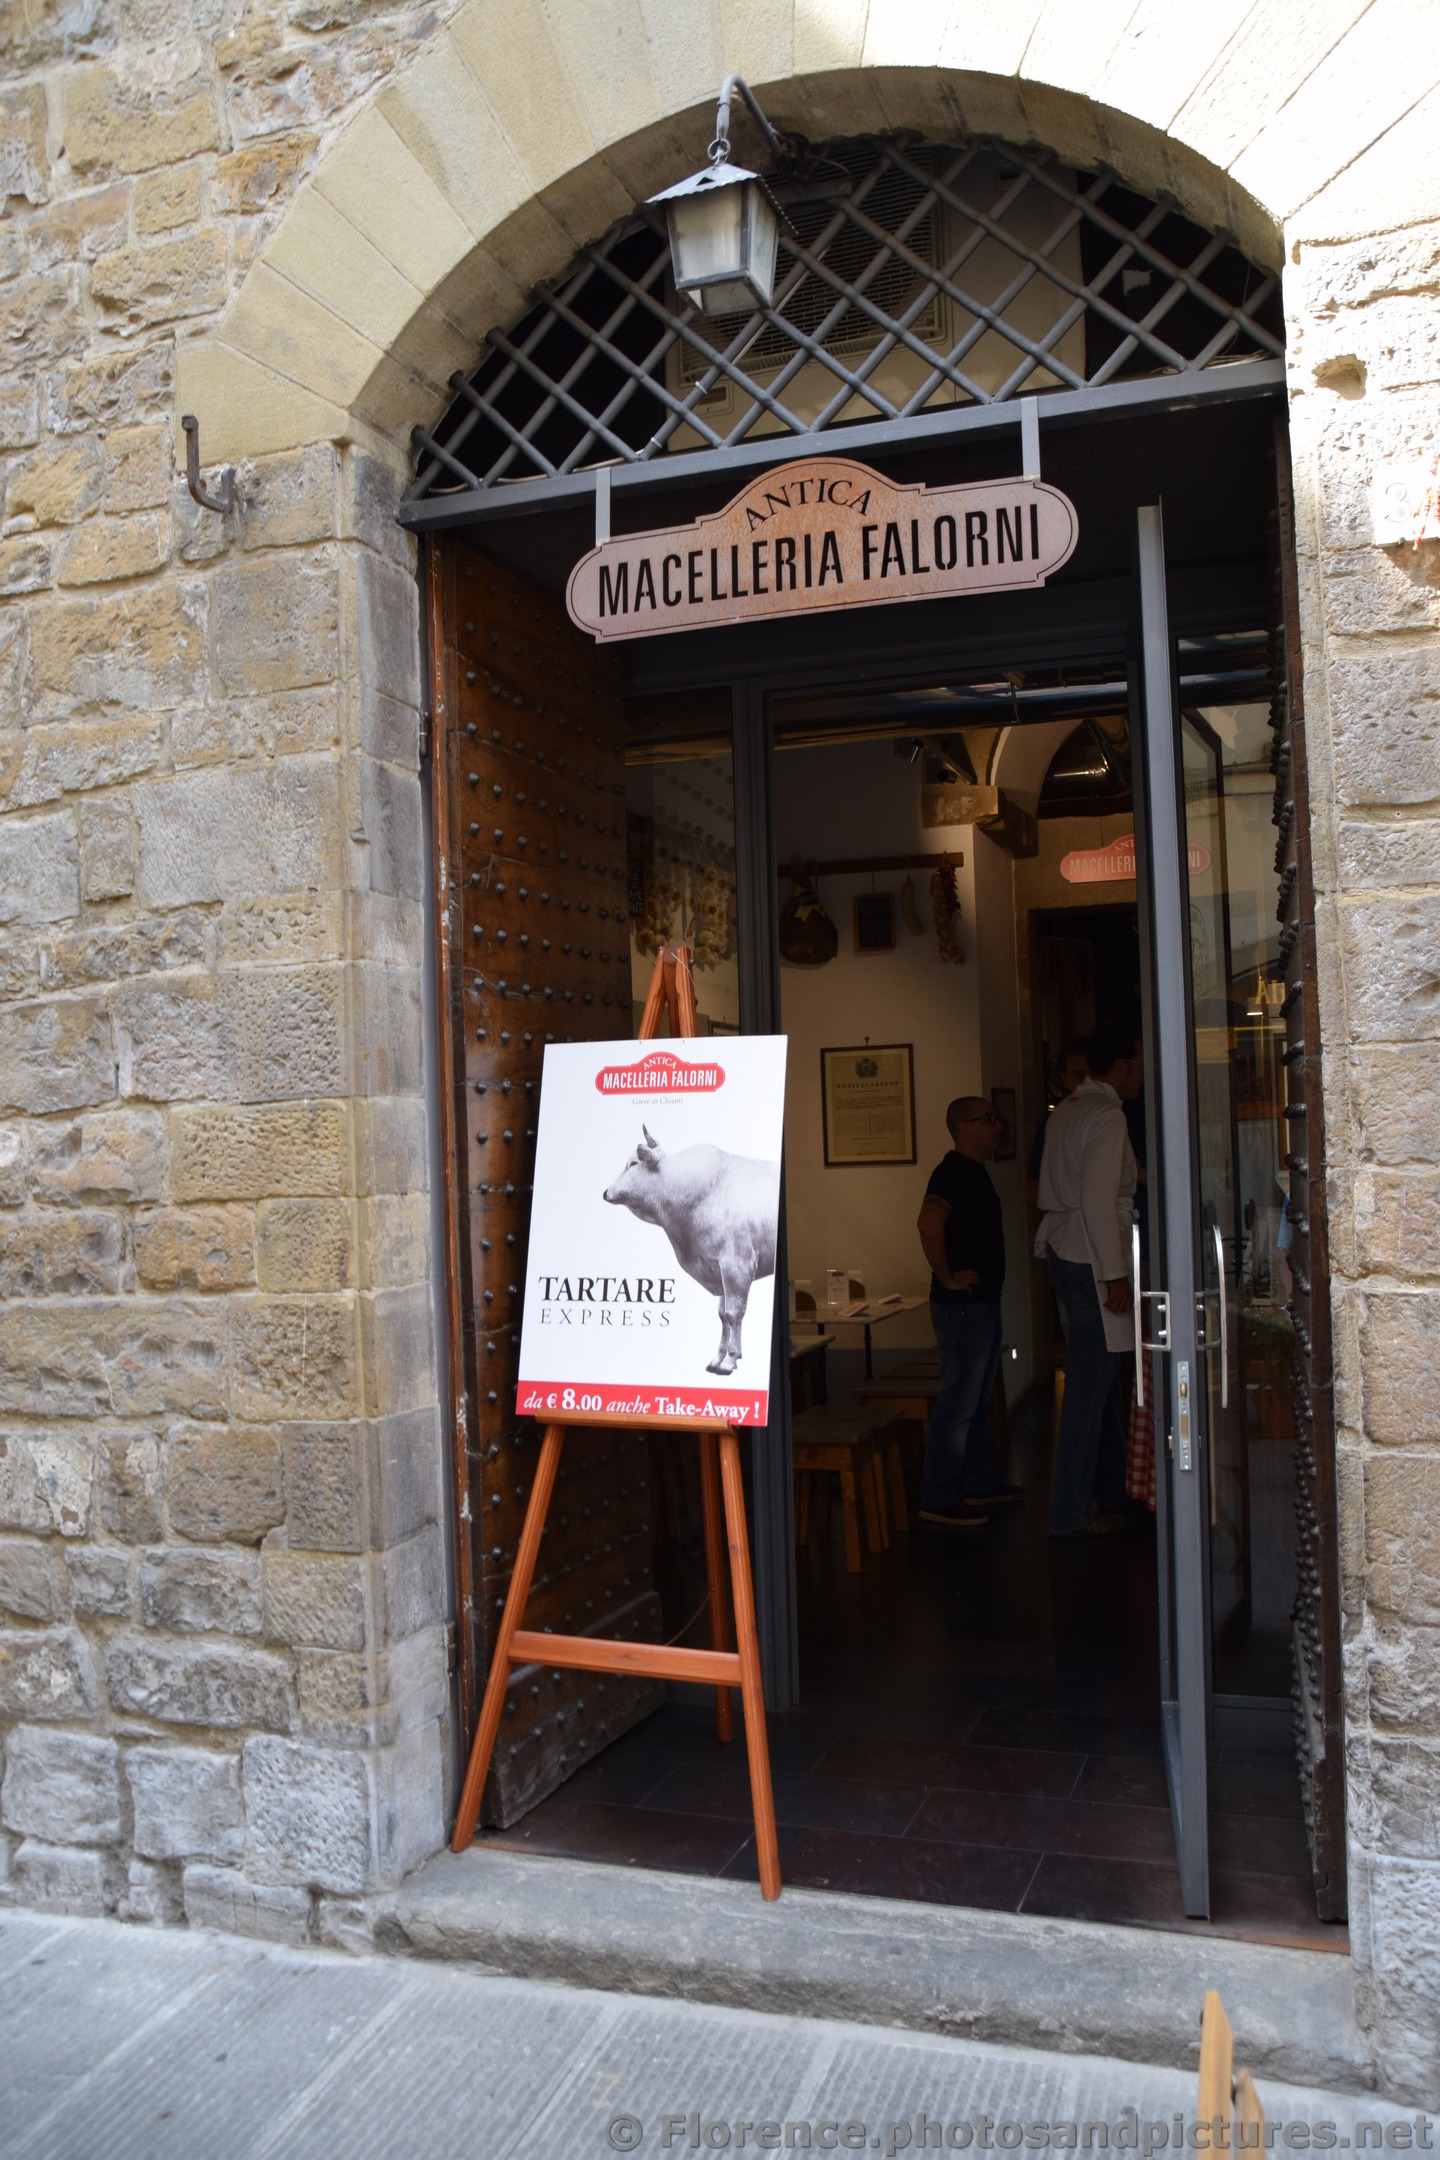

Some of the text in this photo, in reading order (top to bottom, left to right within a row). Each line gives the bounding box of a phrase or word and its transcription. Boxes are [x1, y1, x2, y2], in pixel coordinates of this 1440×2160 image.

[744, 478, 873, 532] ANTICA
[599, 504, 1039, 617] MACELLERIA FALORNI
[1114, 839, 1134, 854] ANT
[1070, 855, 1136, 876] MACELLERI
[643, 1056, 677, 1070] ANTICA
[603, 1069, 717, 1089] MACELLERIA FALORNI
[538, 1276, 676, 1304] TARTARE
[540, 1308, 670, 1327] EXPRESS
[523, 1390, 543, 1409] da
[561, 1388, 603, 1411] 8.00
[606, 1395, 651, 1414] anche
[655, 1396, 750, 1423] Take-Away
